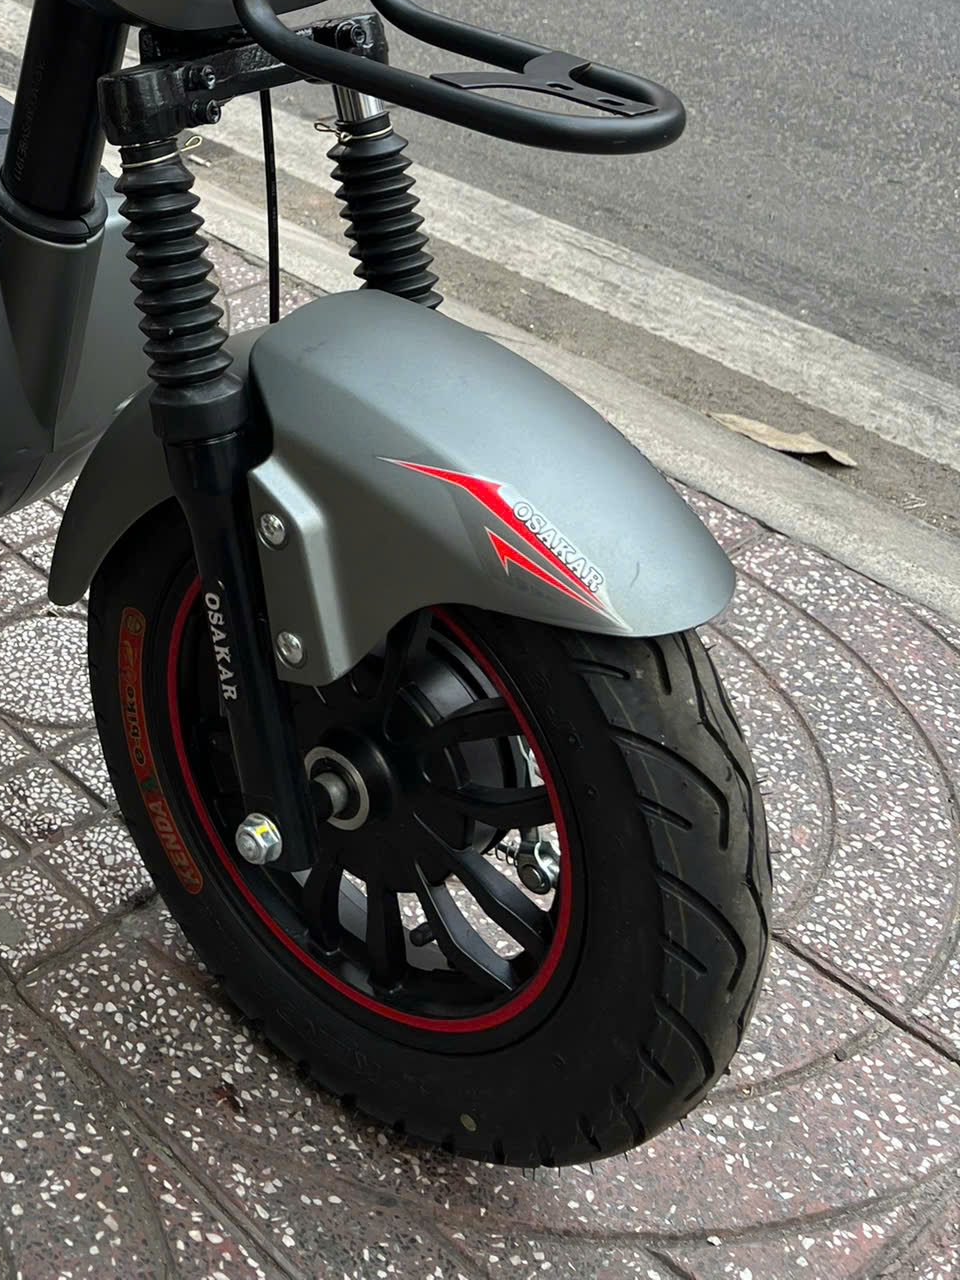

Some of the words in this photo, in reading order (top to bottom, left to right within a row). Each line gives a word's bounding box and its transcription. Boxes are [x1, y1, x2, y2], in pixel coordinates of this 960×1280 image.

[512, 501, 605, 594] OSAKAR
[204, 591, 239, 702] OSAKAR
[147, 799, 200, 886] KENDA
